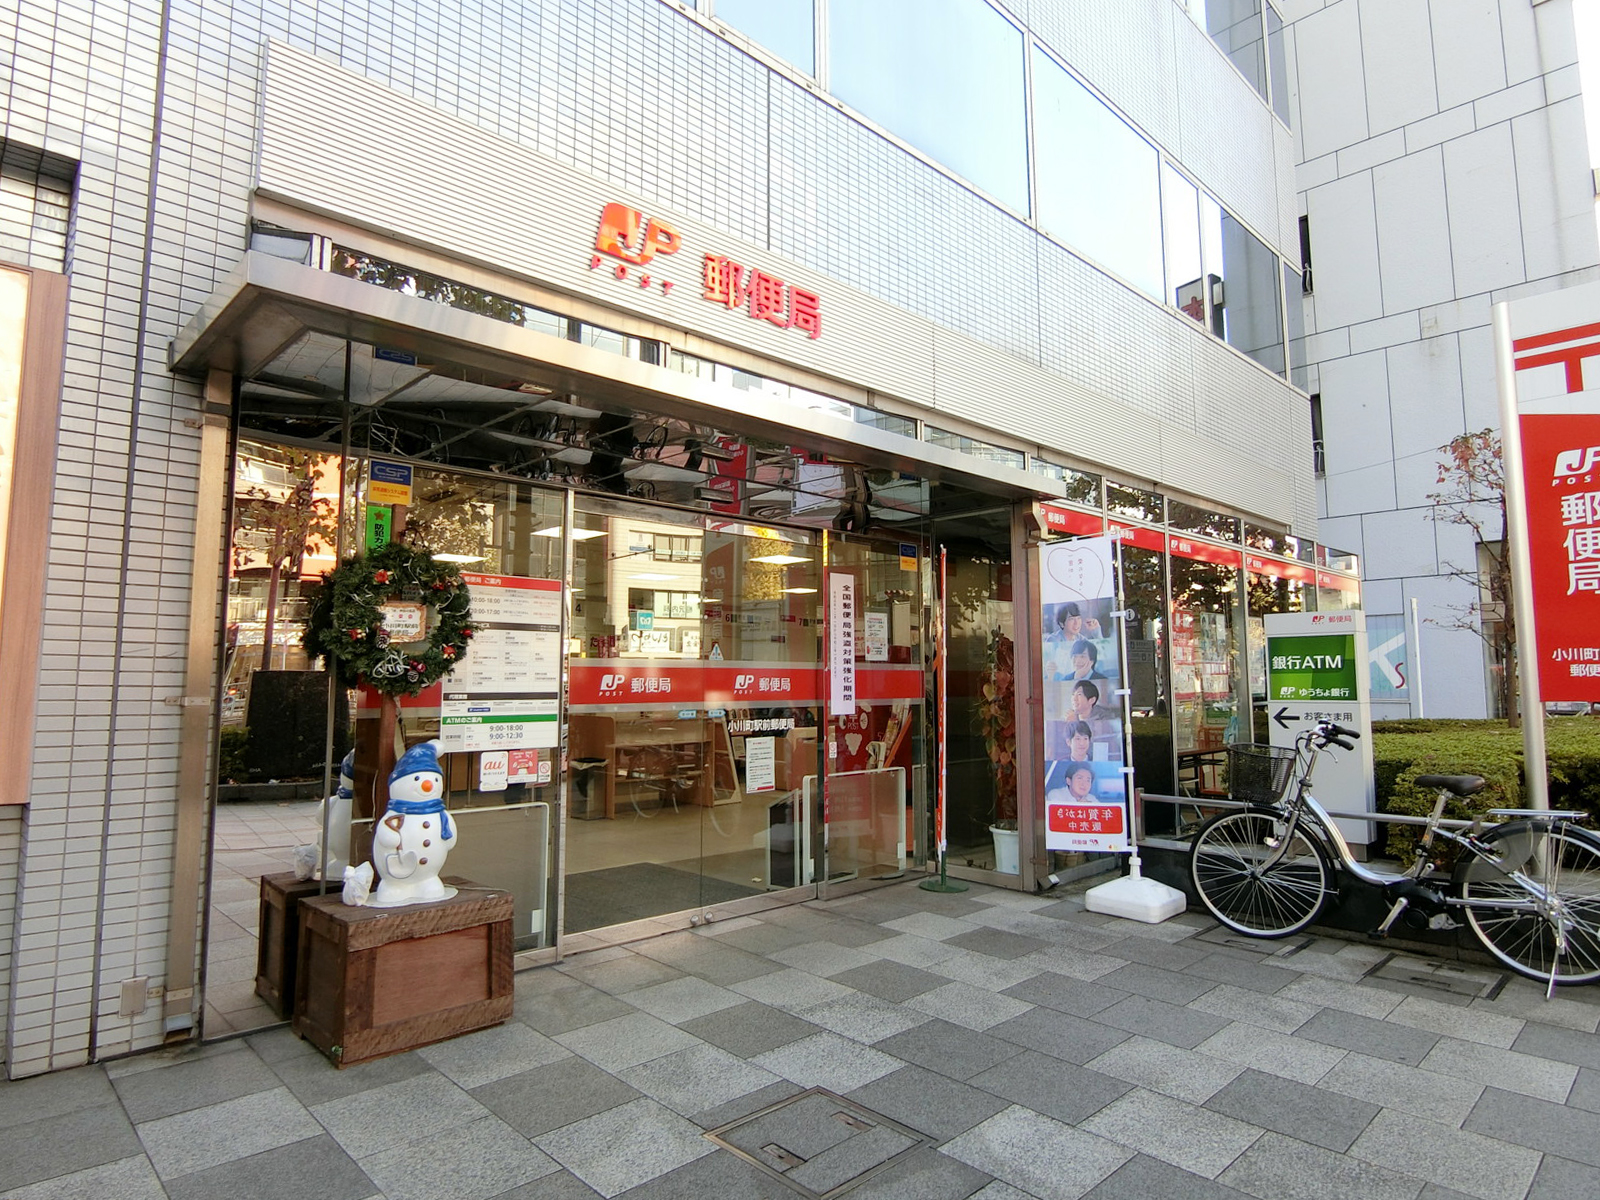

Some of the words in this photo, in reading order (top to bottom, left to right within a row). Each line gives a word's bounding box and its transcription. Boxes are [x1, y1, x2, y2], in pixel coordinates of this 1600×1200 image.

[590, 254, 675, 296] POST
[595, 202, 682, 266] JP
[703, 252, 821, 340] 郵便局
[373, 465, 409, 478] CSP
[1551, 474, 1600, 487] POS
[1048, 512, 1066, 526] 郵便局
[484, 577, 502, 585] ご案内
[1328, 615, 1352, 623] 郵便局
[842, 584, 853, 702] 全国郵便局強盗対策強化期間
[1552, 647, 1600, 661] 小川町
[1272, 655, 1342, 670] 銀行ATM
[600, 674, 625, 691] JP
[630, 677, 672, 693] 郵便局
[734, 674, 754, 690] JP
[758, 677, 791, 692] 郵便局
[1280, 686, 1296, 695] JP
[1299, 687, 1349, 697] ゆうちょ銀行
[1303, 712, 1353, 722] お客さま用
[489, 724, 524, 732] 9:00-18:00
[728, 718, 795, 733] 小川町駅前郵便局
[489, 732, 524, 740] 9:00-12:30
[484, 760, 505, 771] au
